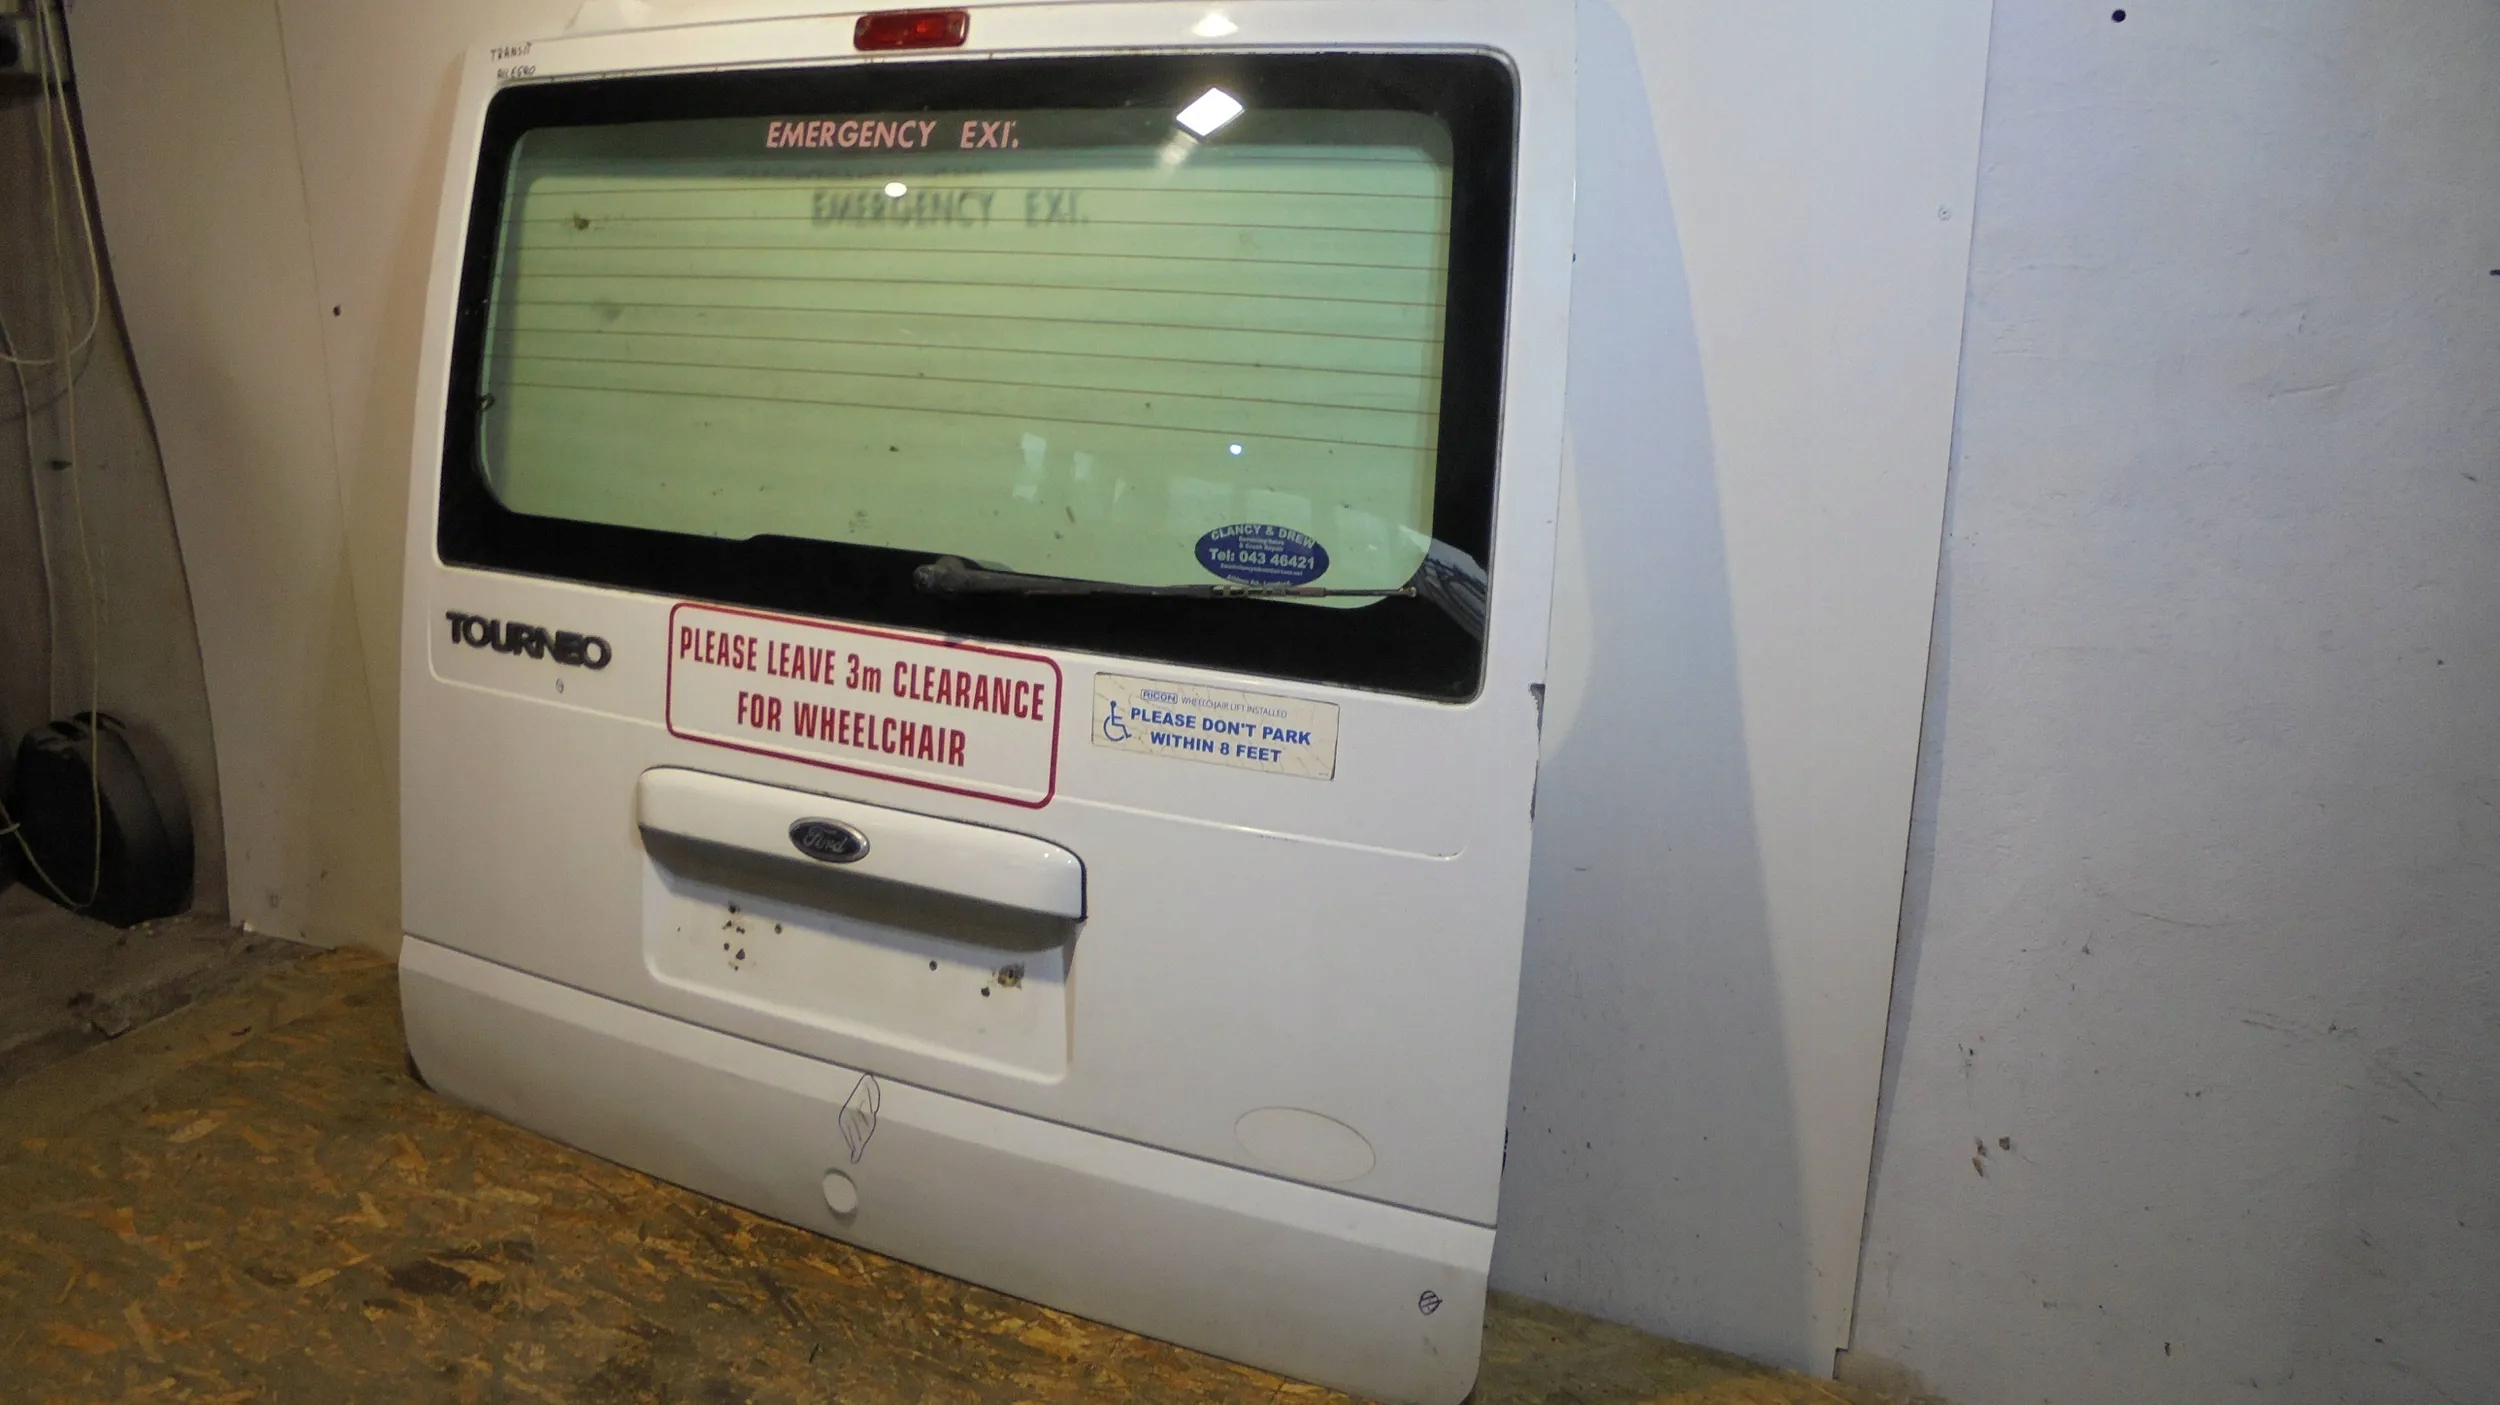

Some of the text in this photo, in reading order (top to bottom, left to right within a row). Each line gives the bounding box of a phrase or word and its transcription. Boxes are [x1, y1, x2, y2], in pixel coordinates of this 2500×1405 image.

[766, 120, 936, 148] EMERGENCY
[1211, 524, 1262, 540] CLANCY
[1265, 525, 1275, 536] &
[1278, 528, 1316, 549] DREW
[1208, 548, 1235, 562] Tel:
[1239, 551, 1266, 565] 043
[1270, 553, 1315, 570] 46421
[445, 609, 612, 670] TOURNEO
[680, 626, 1044, 721] PLEASE LEAVE 3m CLEARANCE
[1143, 690, 1176, 702] RICON
[1230, 704, 1245, 713] LIFT
[1247, 704, 1288, 718] INSTALLED
[737, 690, 967, 767] FOR WHEELCHAIR
[1130, 707, 1312, 745] PLEASE DON'T PARK
[1150, 731, 1282, 762] WITHIN 8 FEET
[803, 826, 848, 854] Ford
